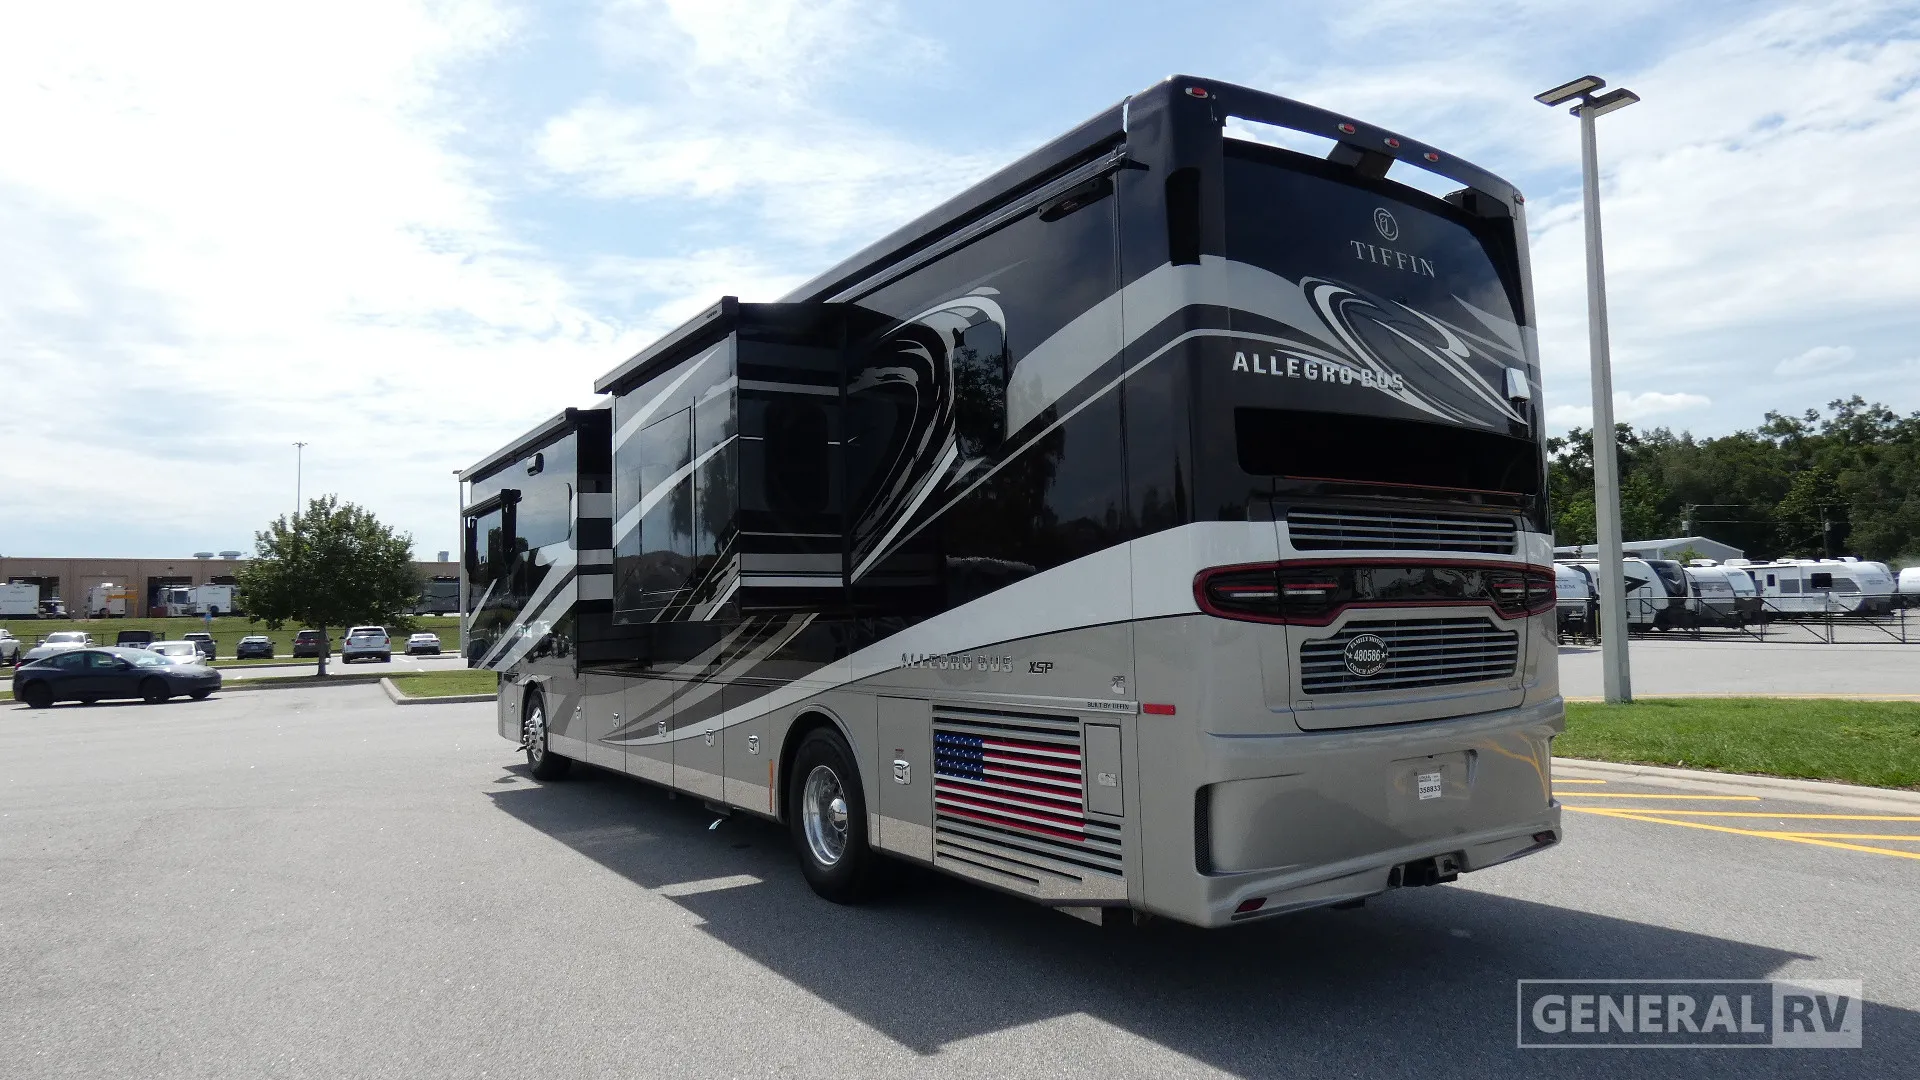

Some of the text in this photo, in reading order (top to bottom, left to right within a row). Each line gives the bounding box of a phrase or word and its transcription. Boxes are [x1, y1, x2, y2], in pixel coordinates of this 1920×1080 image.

[1350, 240, 1435, 278] TIFFIN
[1232, 351, 1403, 391] ALLEGRO BUS
[1350, 636, 1368, 649] FAMILY
[901, 652, 1013, 673] ALLEGRO BUS
[1353, 649, 1381, 662] 480586
[1028, 661, 1053, 674] XSP
